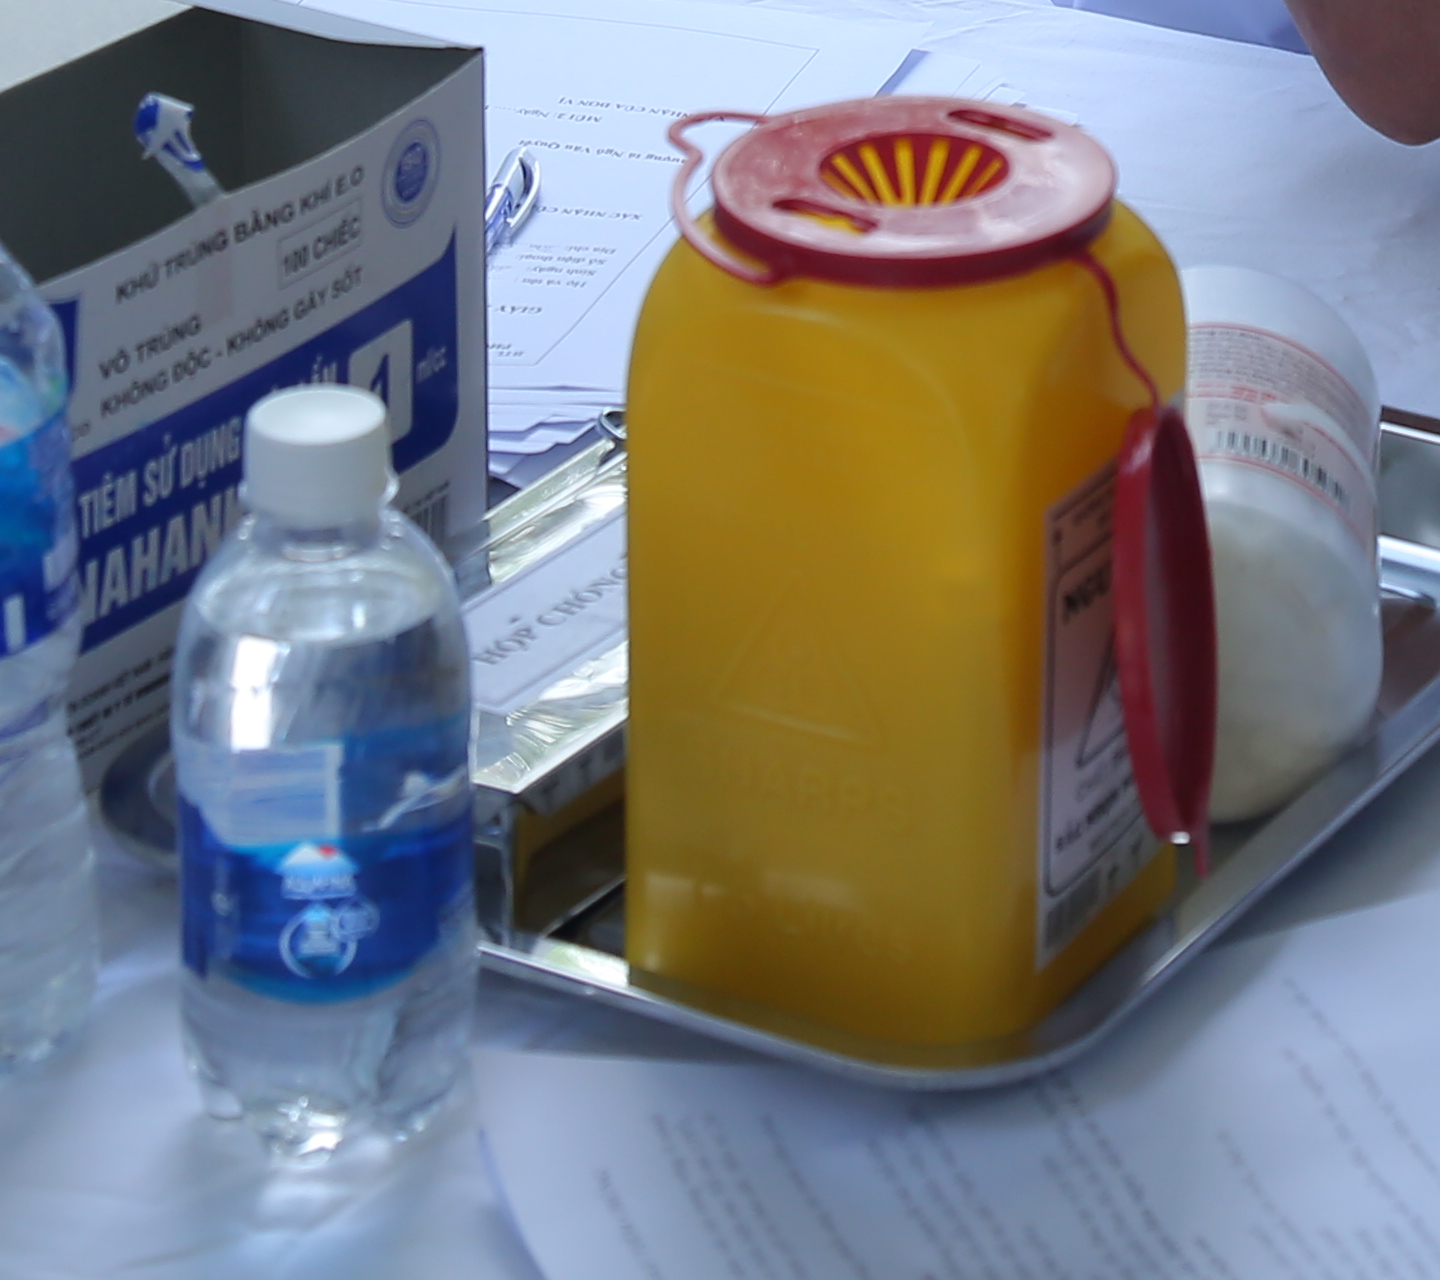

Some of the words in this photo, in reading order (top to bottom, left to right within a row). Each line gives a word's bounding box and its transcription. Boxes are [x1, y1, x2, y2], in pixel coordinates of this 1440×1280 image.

[115, 260, 159, 305] KHỬ
[163, 228, 229, 280] TRÙNG
[298, 176, 333, 214] KHÍ
[98, 347, 130, 381] VÔ
[134, 313, 203, 364] TRÙNG
[100, 367, 170, 419] KHÔNG
[170, 345, 213, 383] ĐỘC
[225, 307, 291, 358] KHÔNG
[292, 285, 331, 322] GÂY
[331, 264, 365, 301] SỐT
[78, 470, 138, 539] TIÊM
[143, 431, 177, 508] SỬ
[180, 414, 243, 490] DỤNG
